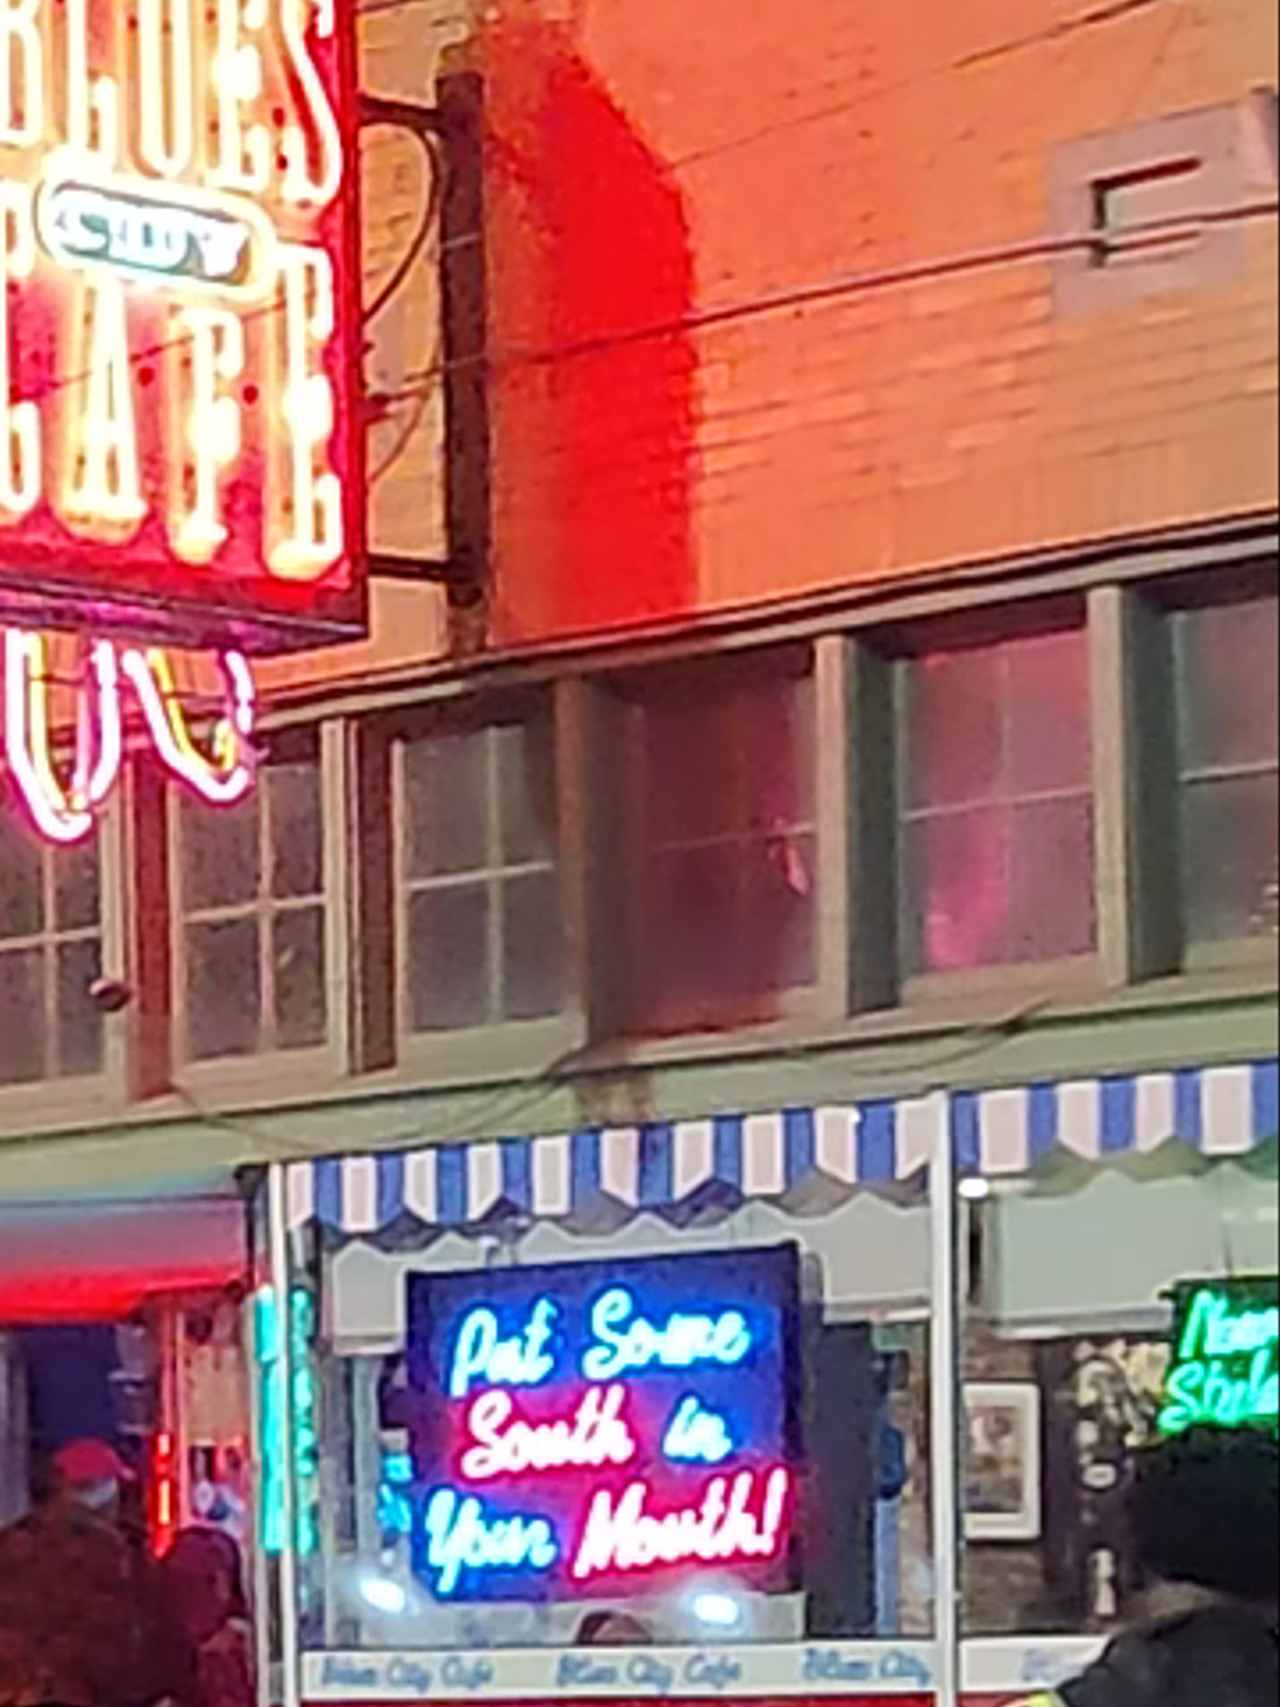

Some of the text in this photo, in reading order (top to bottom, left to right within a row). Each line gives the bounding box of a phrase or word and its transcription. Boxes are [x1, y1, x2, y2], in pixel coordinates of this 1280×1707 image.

[449, 1287, 752, 1398] Put Some
[460, 1383, 734, 1479] South in
[424, 1466, 788, 1593] Your Mouth!
